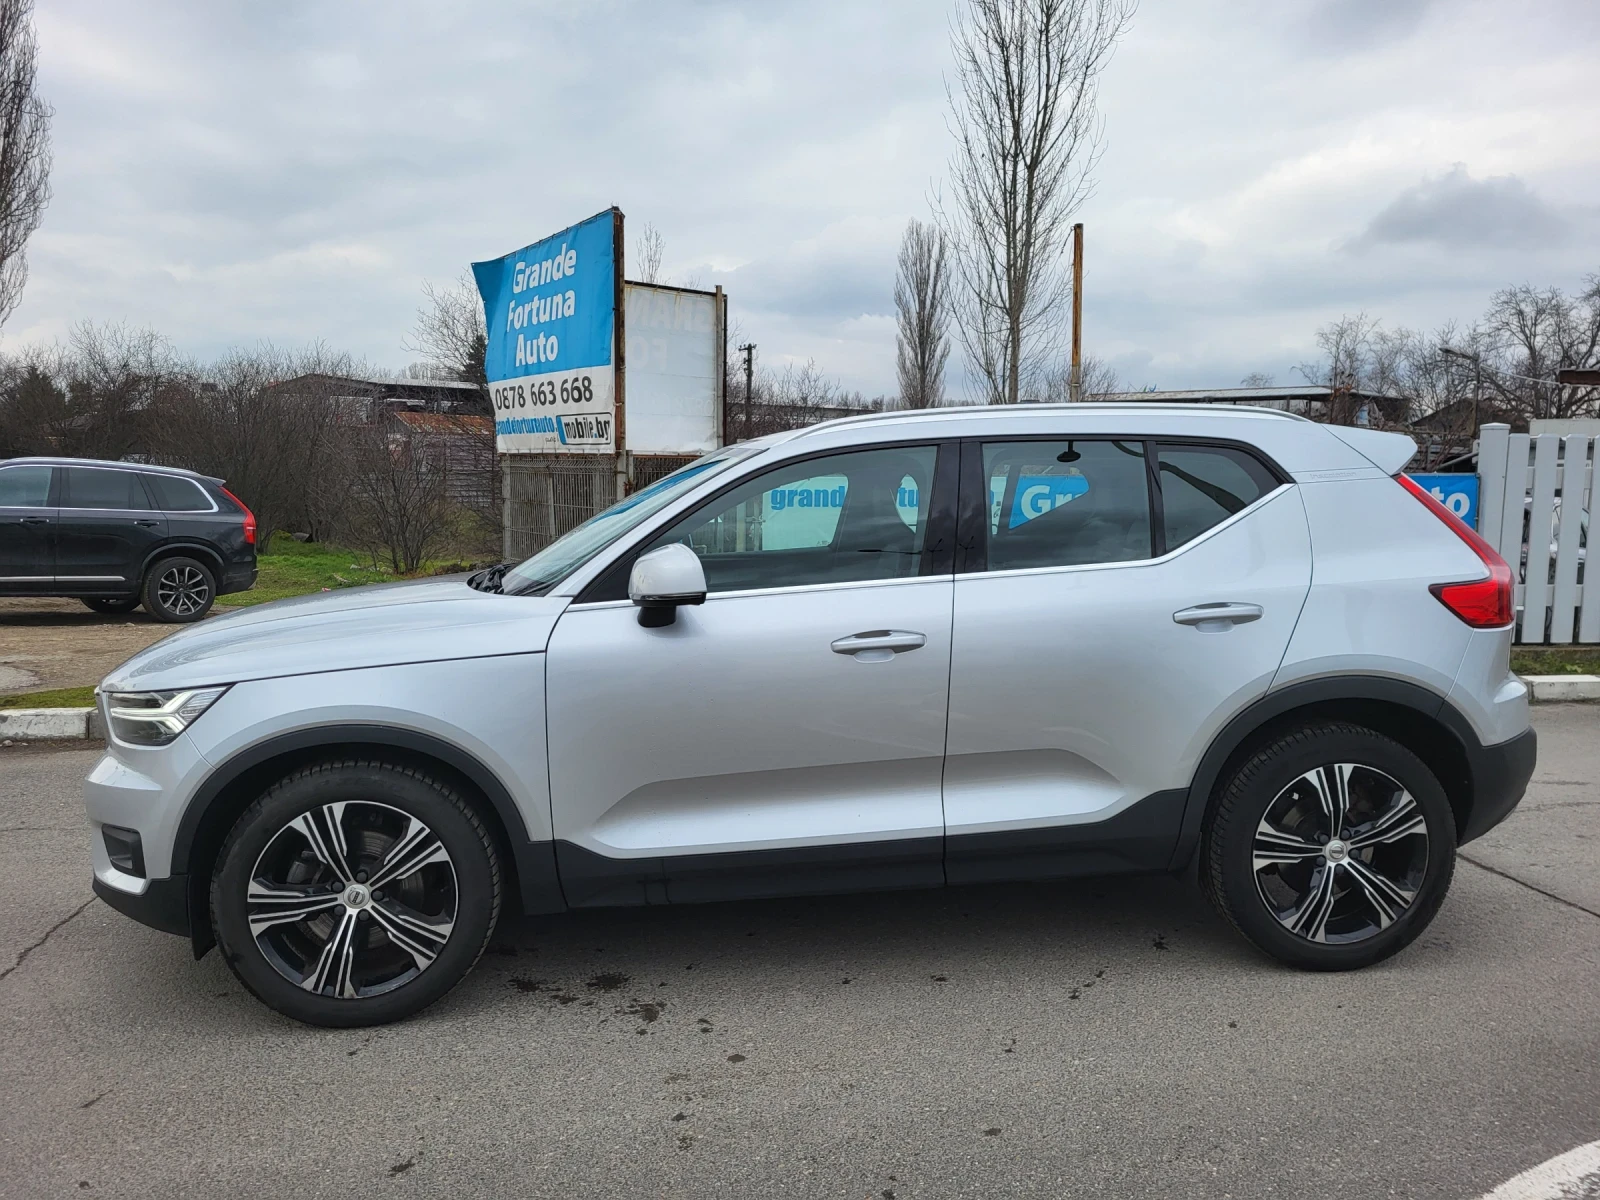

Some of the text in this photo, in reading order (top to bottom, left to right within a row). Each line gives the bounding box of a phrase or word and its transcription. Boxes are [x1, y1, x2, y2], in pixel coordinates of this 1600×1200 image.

[512, 243, 577, 294] Grande
[506, 290, 576, 332] Fortuna
[515, 331, 559, 367] Auto
[495, 376, 593, 410] 0878 663 668
[771, 486, 845, 511] grand
